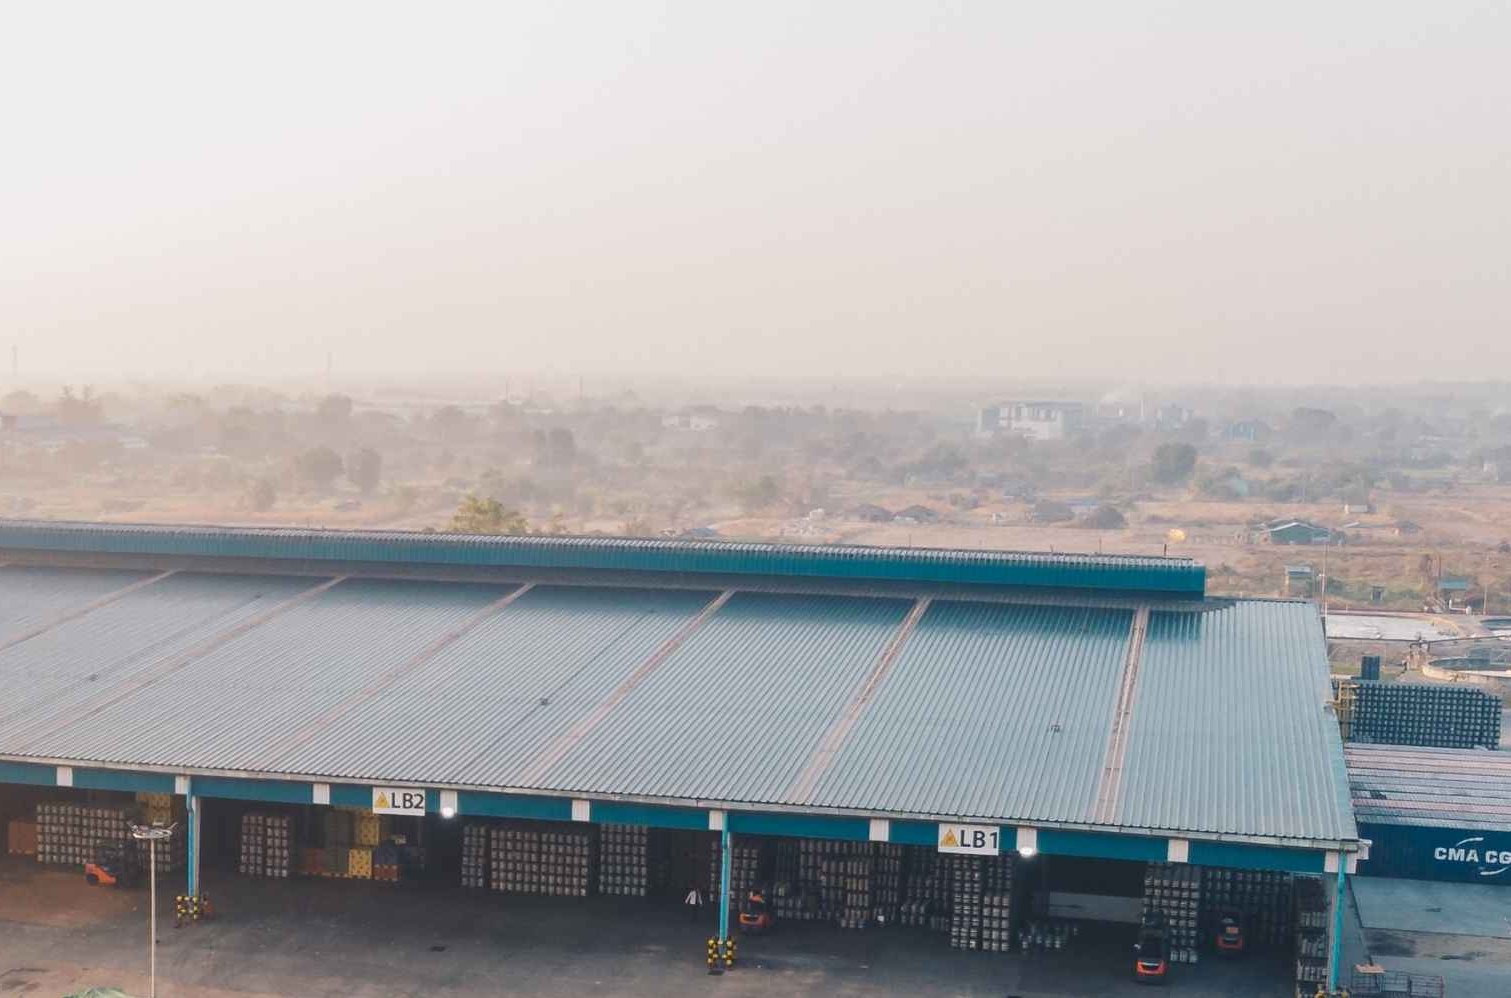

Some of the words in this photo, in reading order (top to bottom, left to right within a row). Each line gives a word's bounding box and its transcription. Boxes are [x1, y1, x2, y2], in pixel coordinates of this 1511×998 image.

[391, 792, 424, 809] LB2
[960, 829, 998, 849] LB1
[1434, 847, 1479, 863] CMA
